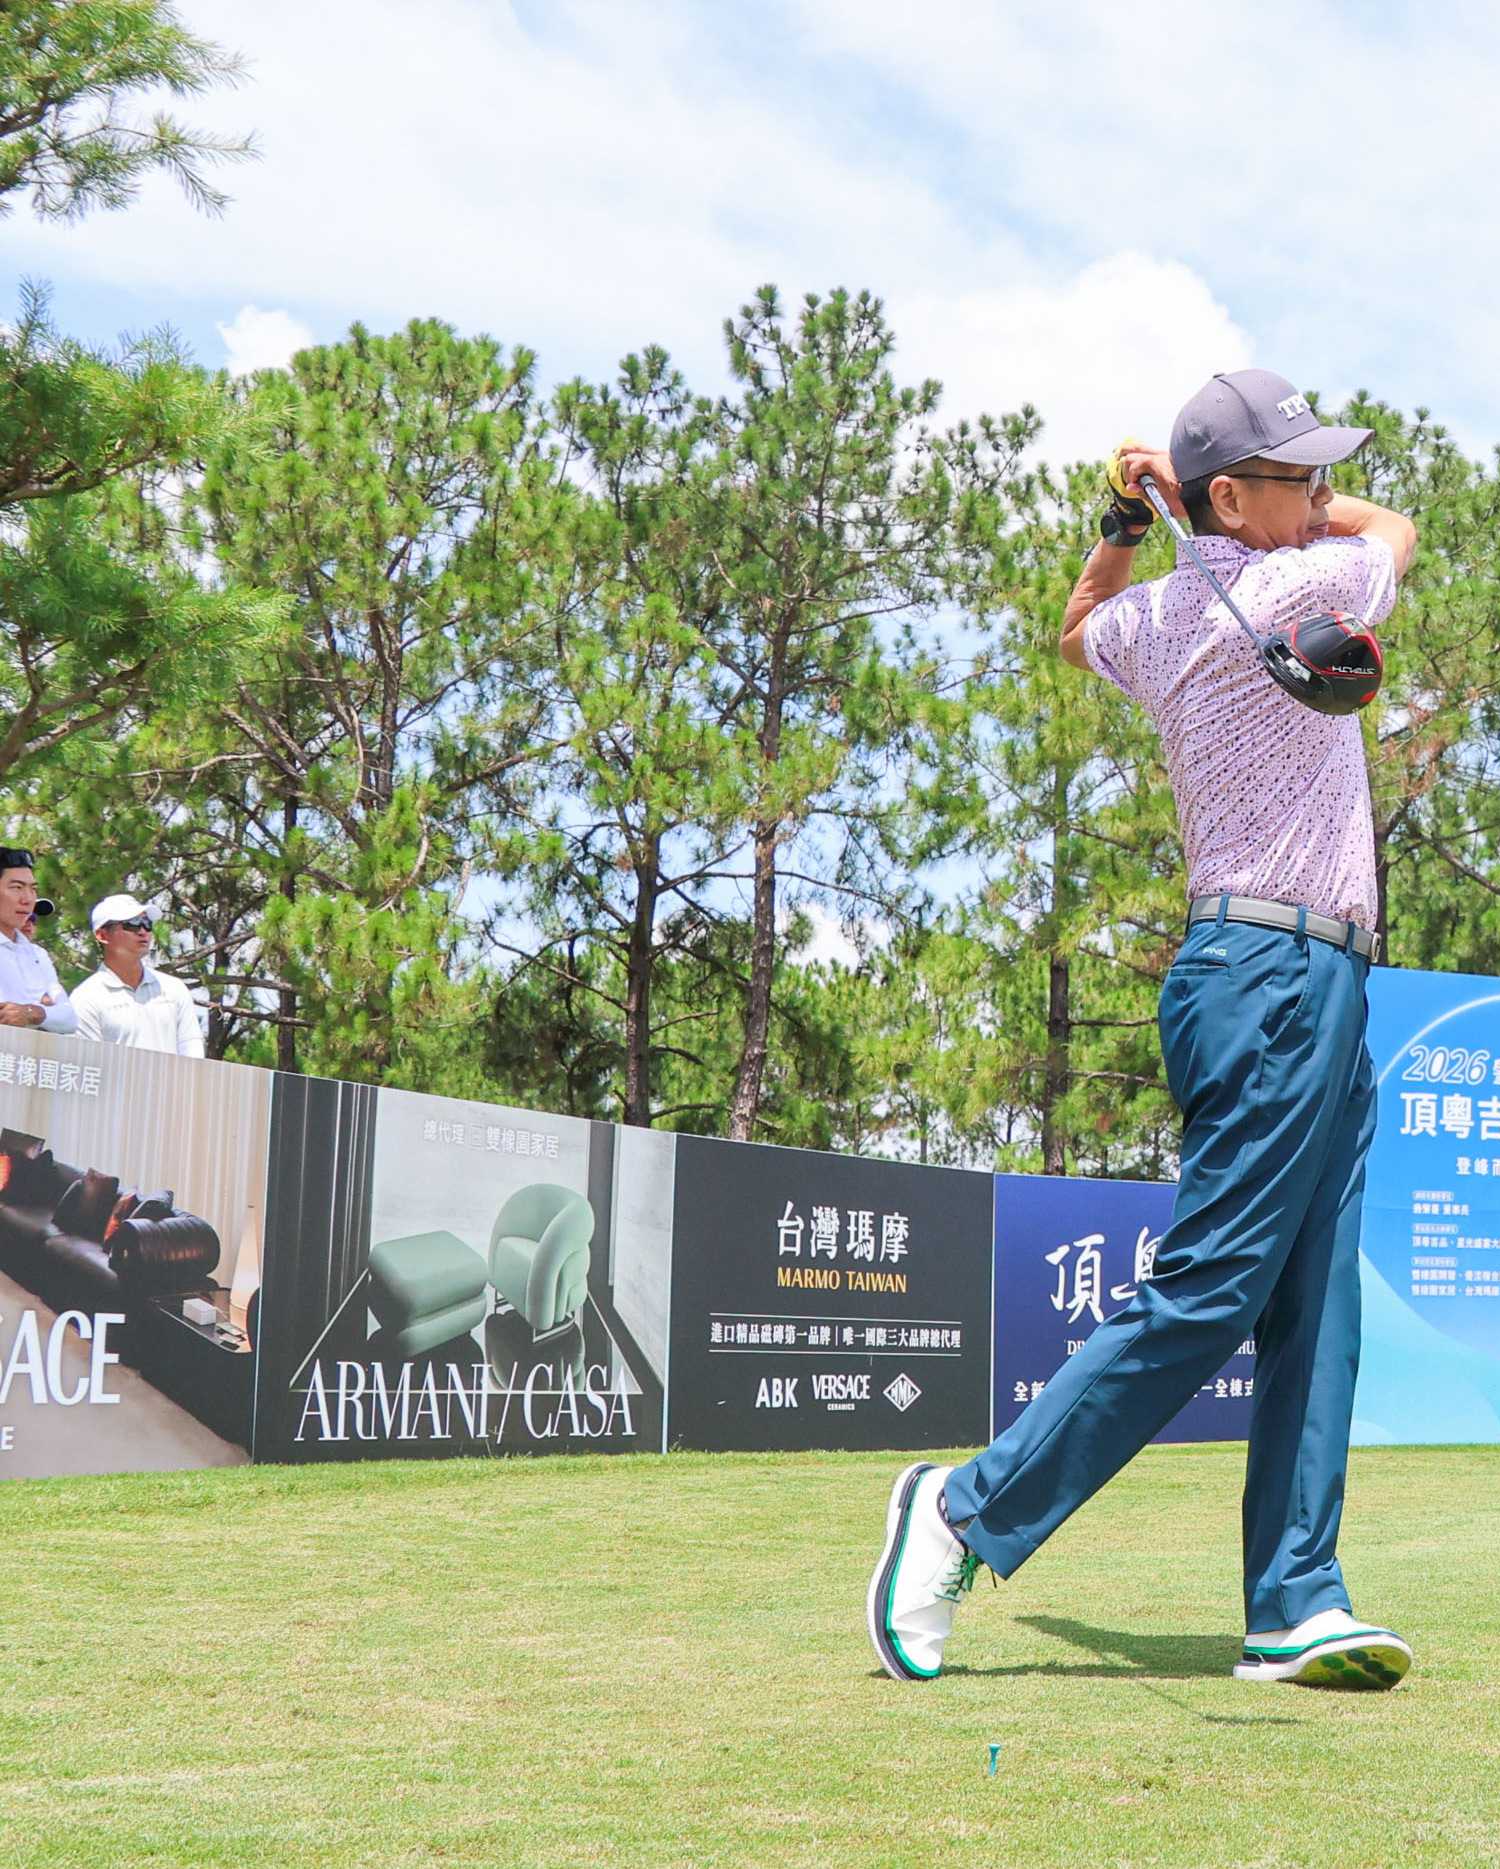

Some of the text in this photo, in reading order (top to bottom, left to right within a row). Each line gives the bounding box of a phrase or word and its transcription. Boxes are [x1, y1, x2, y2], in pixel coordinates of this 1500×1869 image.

[1202, 946, 1228, 957] PING
[0, 1051, 101, 1096] 雙橡園家居
[1401, 1045, 1491, 1085] 2026
[424, 1119, 560, 1159] 總代理 雙橡園家居
[777, 1200, 910, 1264] 台灣瑪摩
[777, 1266, 907, 1294] MARMO TAIWAN
[0, 1310, 126, 1406] ACE
[294, 1358, 492, 1441] ARMANI
[523, 1363, 637, 1438] CASA
[755, 1377, 799, 1409] ABK
[812, 1374, 871, 1400] VERSACE
[827, 1403, 856, 1411] CERAMICS
